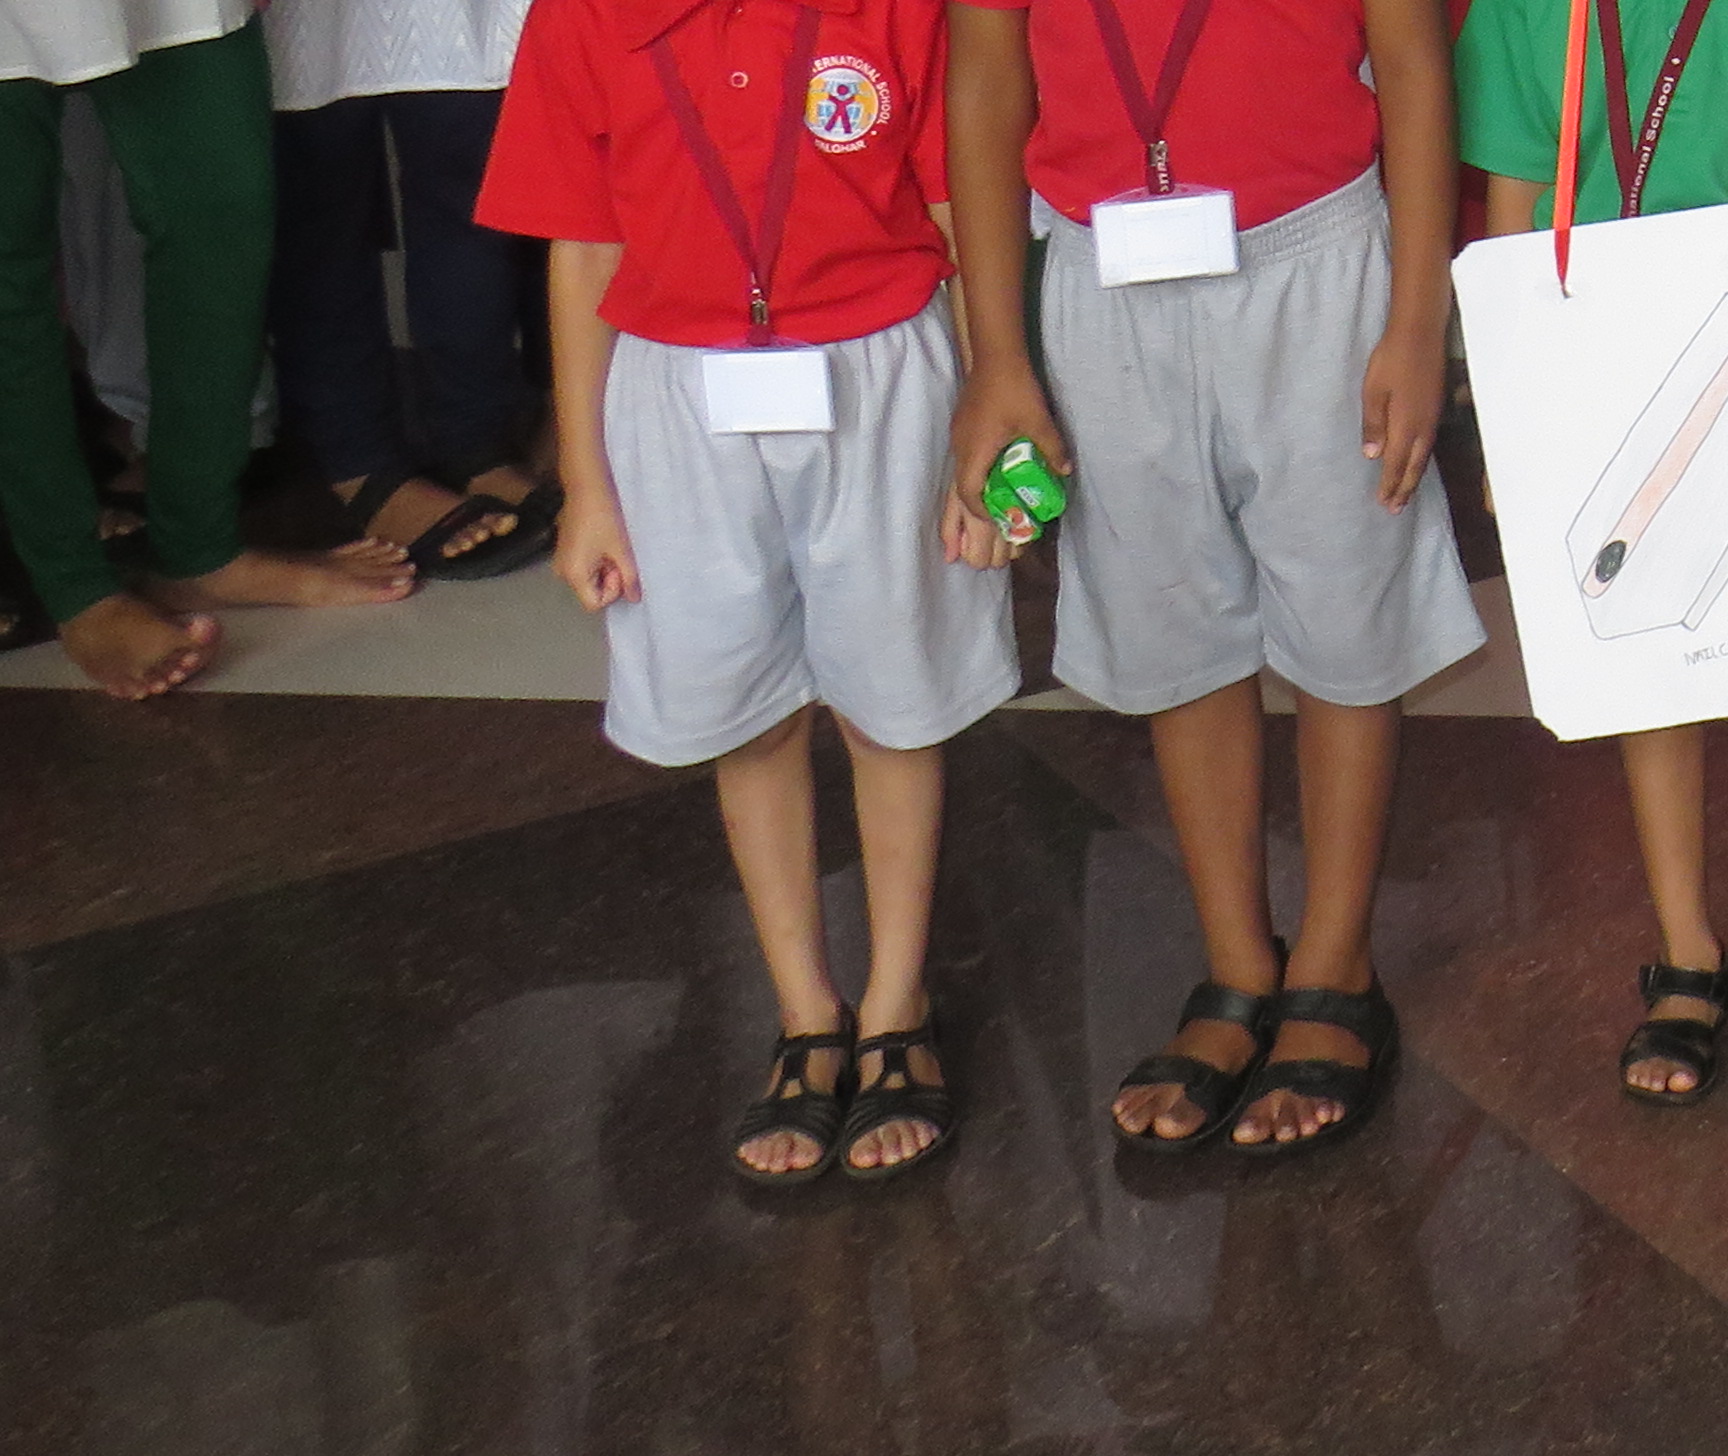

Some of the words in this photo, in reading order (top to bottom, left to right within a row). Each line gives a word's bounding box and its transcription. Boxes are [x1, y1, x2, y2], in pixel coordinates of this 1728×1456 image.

[812, 55, 881, 83] ERNATIONAL
[876, 81, 892, 125] SCHOOL
[1645, 76, 1675, 142] School
